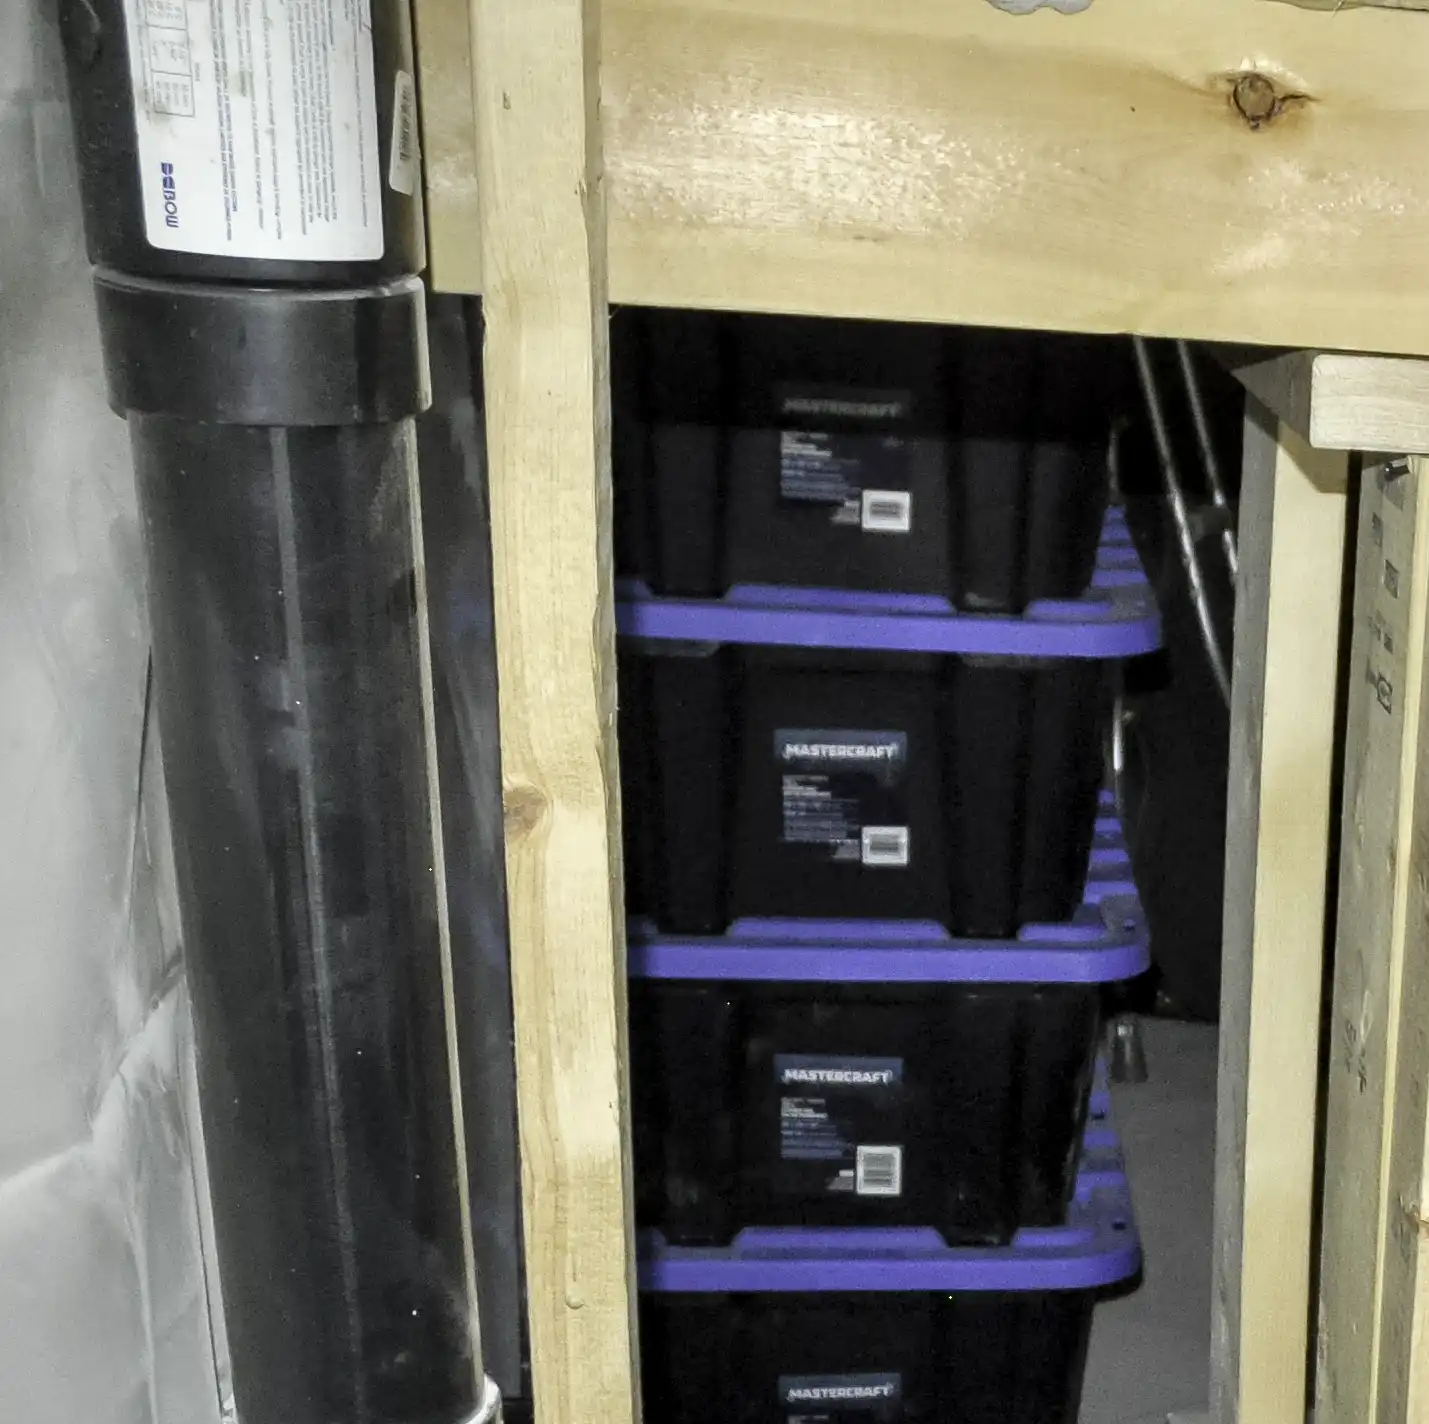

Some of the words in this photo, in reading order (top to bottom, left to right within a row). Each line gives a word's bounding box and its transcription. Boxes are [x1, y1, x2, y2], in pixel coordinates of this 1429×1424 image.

[783, 743, 896, 760] MASTERCRAFT
[782, 1068, 890, 1084] MASTERCRAFT
[787, 1386, 890, 1402] MASTERCRAFT
